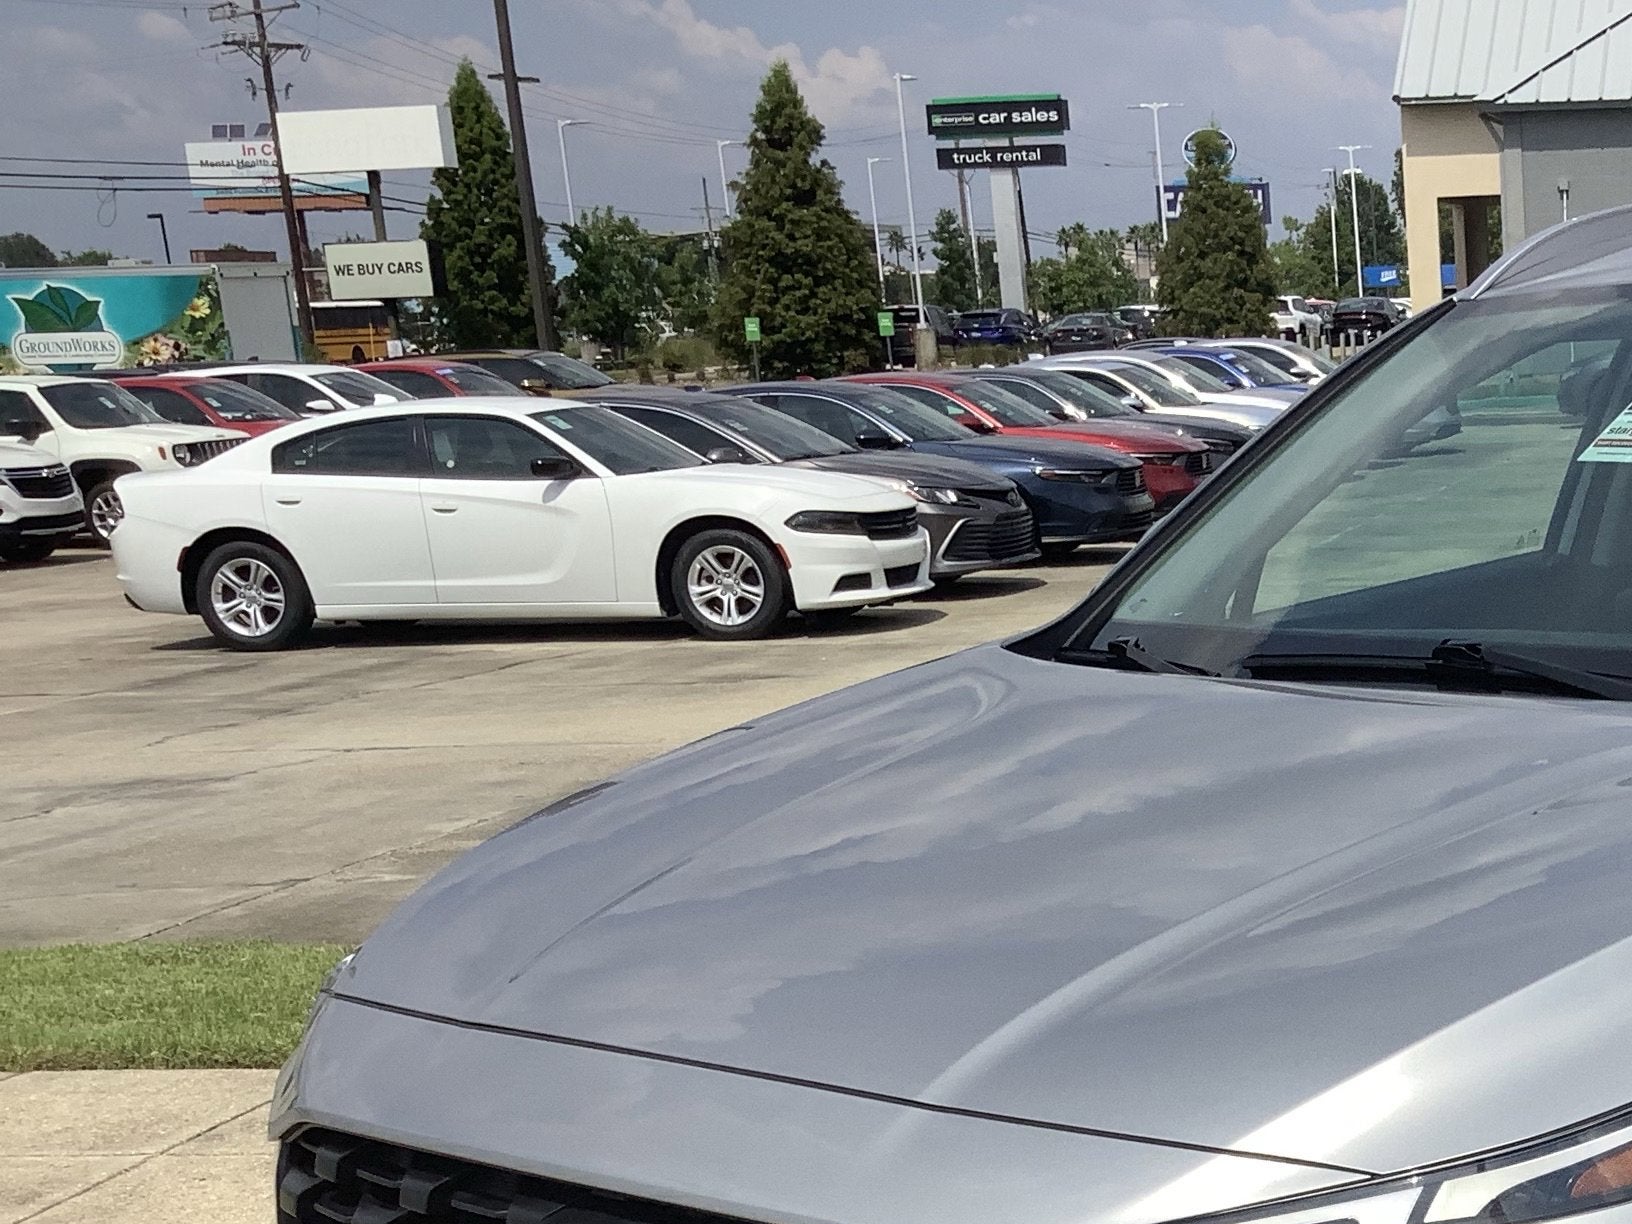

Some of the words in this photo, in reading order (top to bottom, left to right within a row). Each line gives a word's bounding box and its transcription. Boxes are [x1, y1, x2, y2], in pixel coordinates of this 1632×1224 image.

[934, 115, 974, 125] enterprise
[978, 113, 1007, 124] car
[1012, 107, 1059, 123] sales
[241, 144, 257, 156] In
[952, 149, 993, 164] truck
[997, 148, 1041, 162] rental
[200, 159, 234, 168] Mental
[236, 158, 270, 168] Health
[333, 263, 355, 276] WE
[357, 262, 384, 275] BUY
[387, 261, 424, 274] CARS
